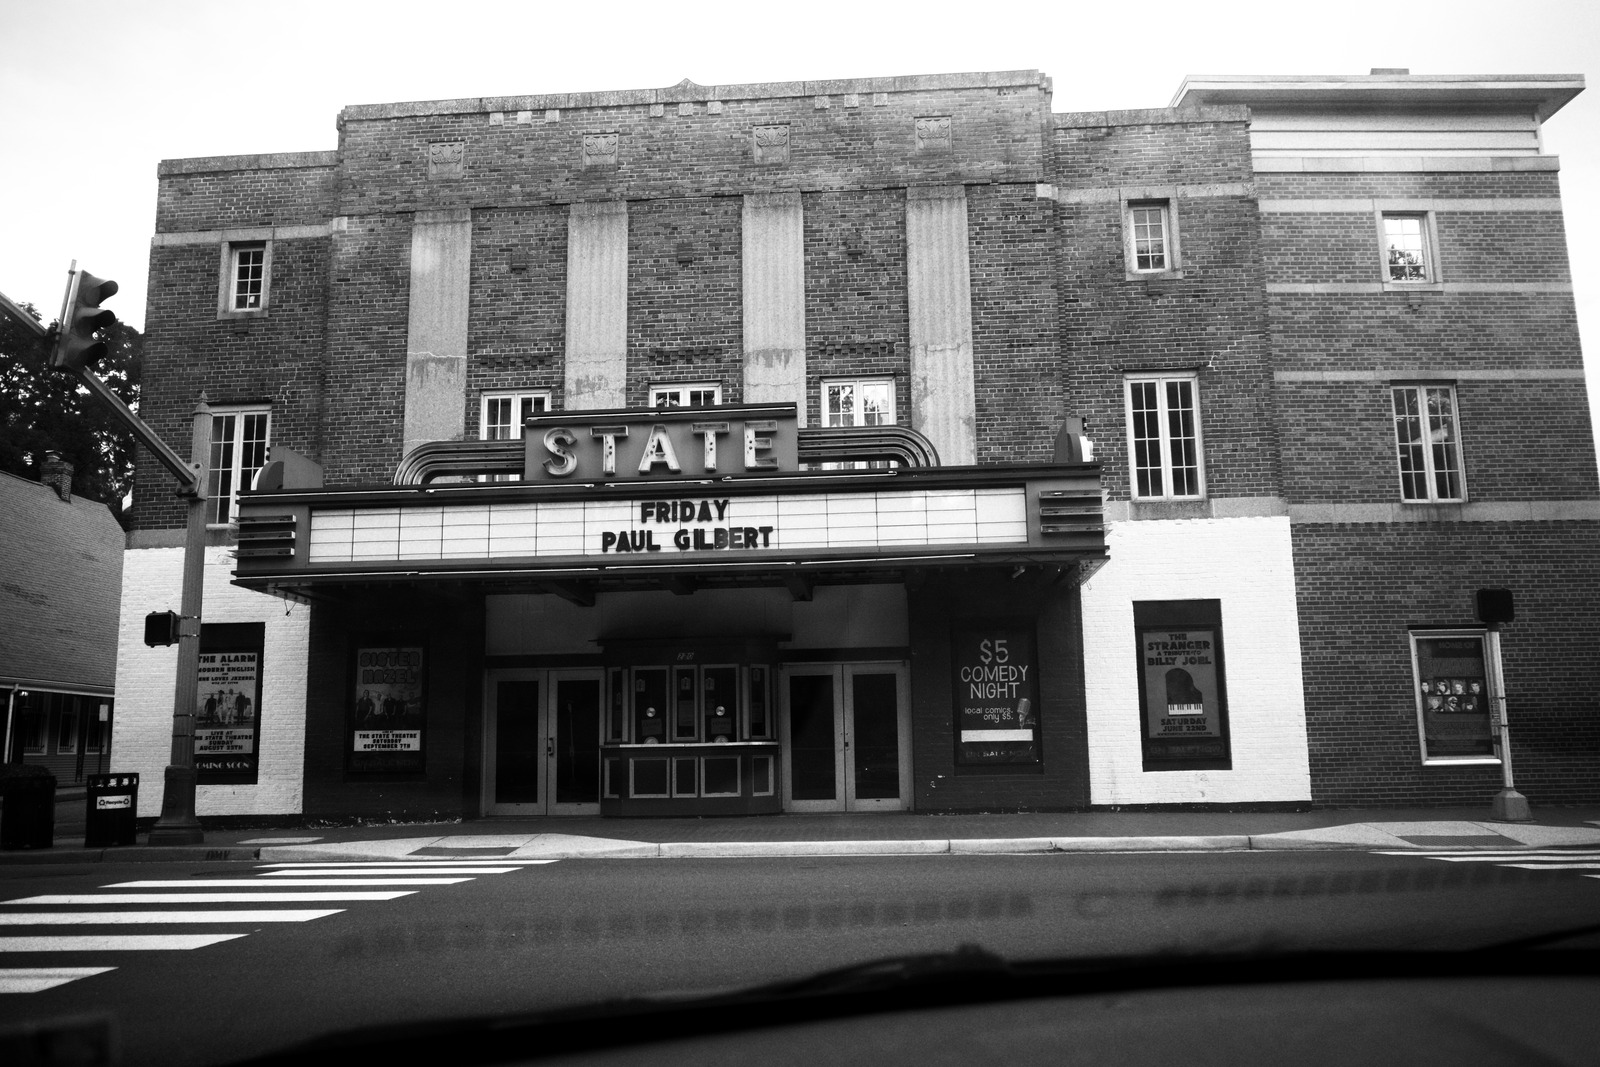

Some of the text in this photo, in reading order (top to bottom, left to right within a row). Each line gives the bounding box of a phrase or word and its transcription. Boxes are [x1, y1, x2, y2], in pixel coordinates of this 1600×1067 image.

[542, 419, 779, 477] STATE
[640, 499, 729, 523] FRIDAY
[602, 525, 774, 553] PAUL GILBERT
[980, 638, 1009, 664] $5
[1148, 640, 1210, 650] STRANGER
[220, 655, 256, 663] ALARM
[360, 651, 420, 667] SISTER
[1147, 656, 1212, 666] BILLY JOEL
[362, 669, 416, 684] HAZEL
[960, 664, 1028, 682] COMEDY
[970, 682, 1020, 699] NIGHT
[983, 714, 1000, 723] only
[1160, 718, 1207, 726] SATURDAY
